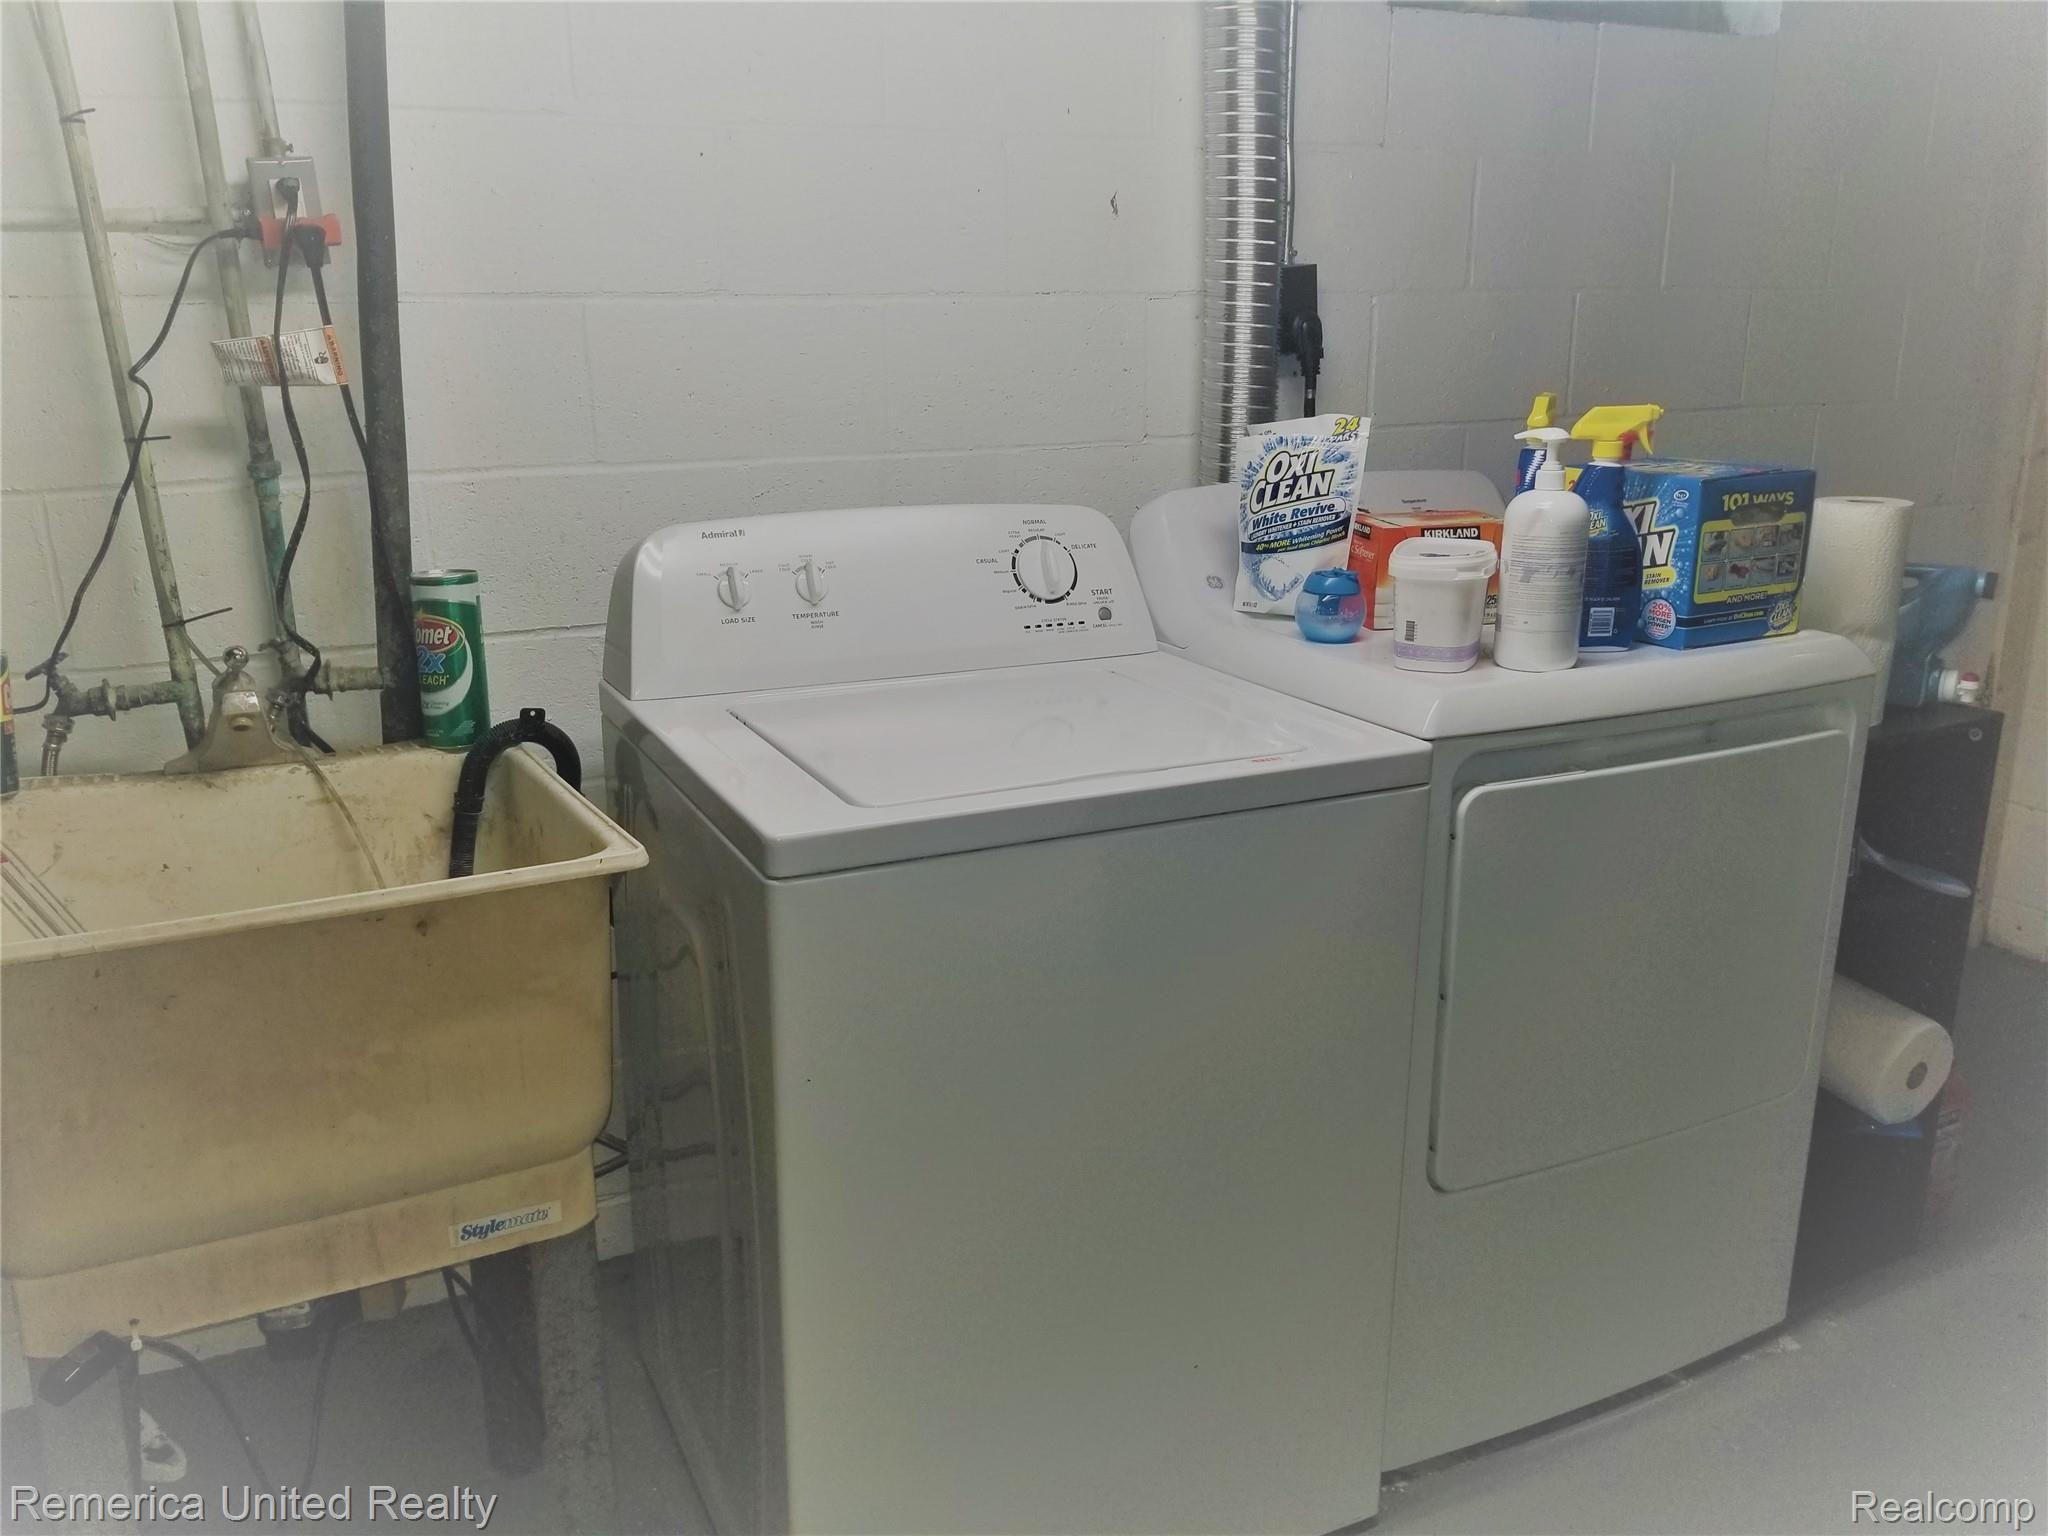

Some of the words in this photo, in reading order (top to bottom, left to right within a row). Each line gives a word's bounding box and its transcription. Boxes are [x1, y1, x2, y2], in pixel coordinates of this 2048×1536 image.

[1332, 417, 1361, 436] 24
[1265, 450, 1320, 484] OXI
[1250, 469, 1335, 514] CLEAN
[1722, 492, 1750, 512] 101
[1752, 491, 1795, 506] WAYS
[1252, 512, 1287, 531] White
[1290, 503, 1336, 520] Revive
[1623, 500, 1657, 536] XI
[701, 529, 738, 540] Admiral
[1269, 539, 1292, 549] MORE
[1292, 532, 1325, 545] Whitening
[1325, 525, 1345, 536] Power
[1423, 528, 1479, 539] KIRKLAND
[1643, 577, 1670, 586] REMOVER
[1645, 572, 1662, 580] STAIN
[1090, 588, 1113, 596] START
[1726, 594, 1743, 604] AND
[1651, 601, 1672, 612] 20%
[792, 610, 840, 620] TEMPERATURE
[1648, 608, 1673, 619] MORE
[720, 617, 740, 625] LOAD
[740, 616, 757, 624] SIZE
[415, 627, 453, 645] omet
[460, 1208, 549, 1241] Stylemate
